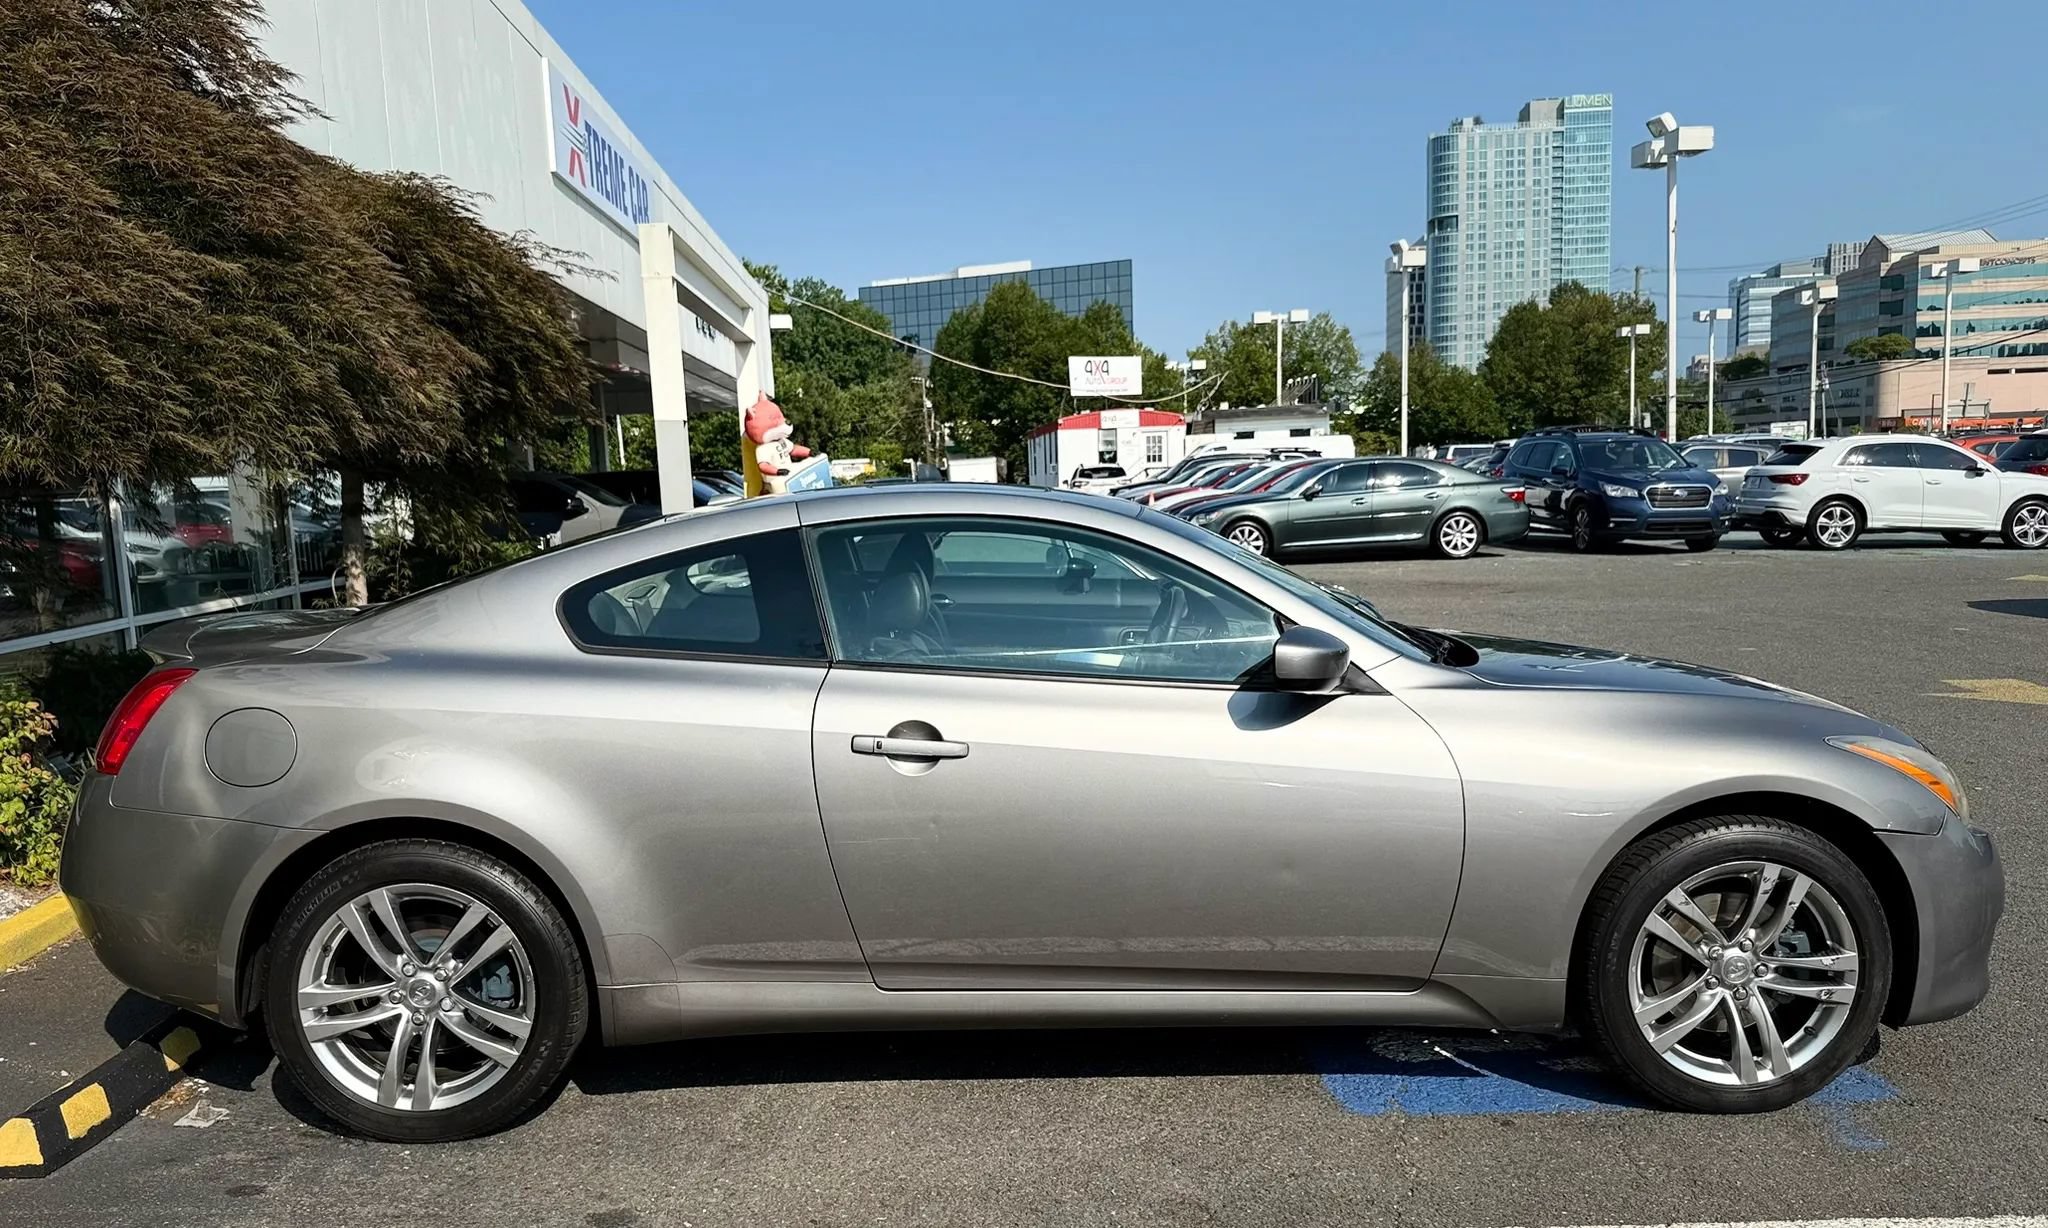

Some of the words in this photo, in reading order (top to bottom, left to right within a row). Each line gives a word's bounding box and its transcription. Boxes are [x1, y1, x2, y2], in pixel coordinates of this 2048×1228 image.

[1565, 93, 1613, 107] LUMEN
[562, 82, 629, 216] XTREME
[628, 165, 650, 224] CAR
[296, 880, 342, 928] MICHELIN
